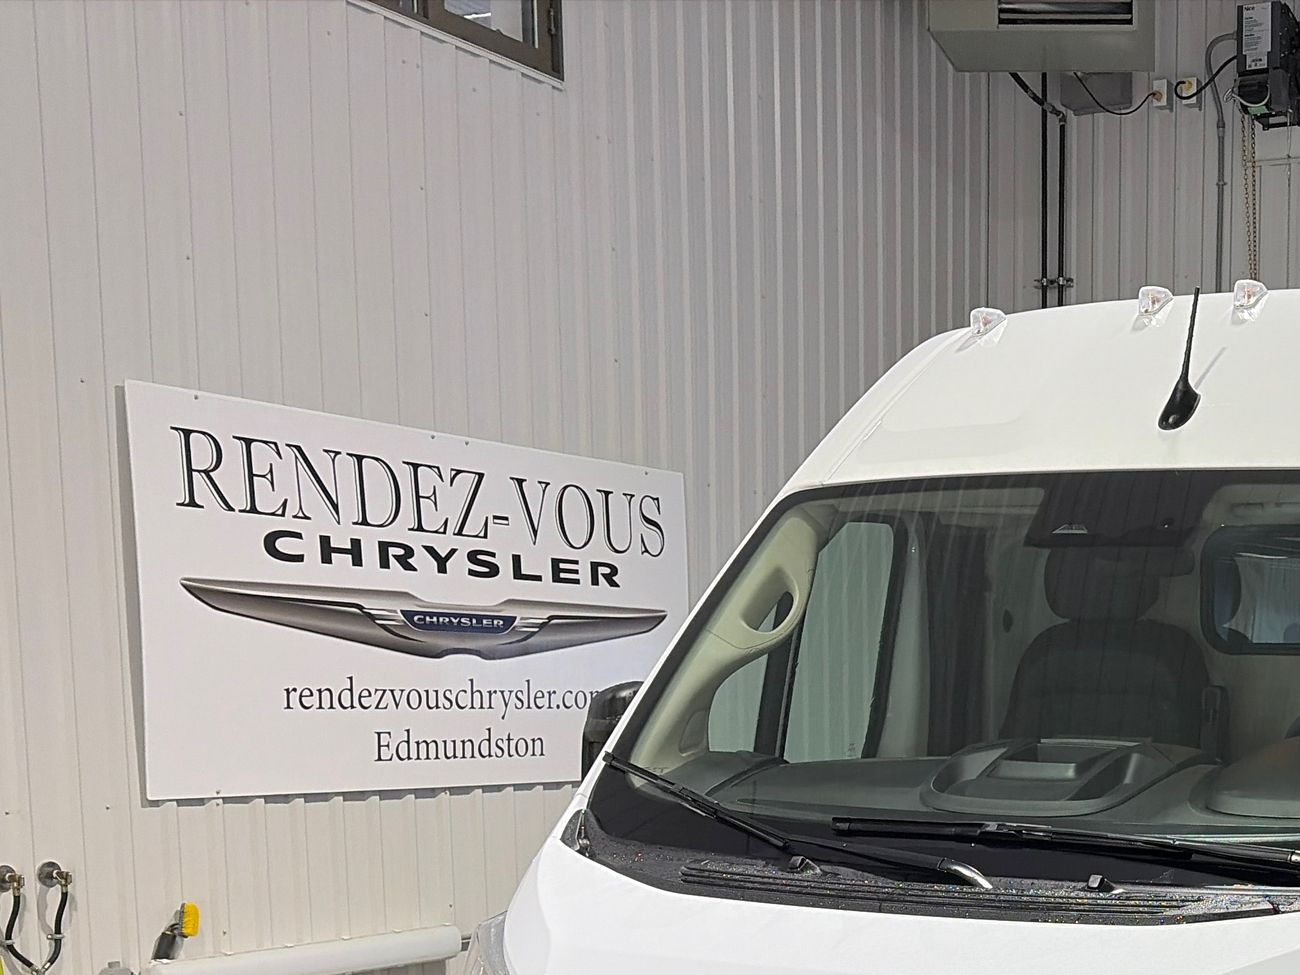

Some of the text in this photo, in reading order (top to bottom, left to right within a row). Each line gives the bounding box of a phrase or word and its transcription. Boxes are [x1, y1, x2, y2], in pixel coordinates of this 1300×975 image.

[169, 425, 667, 558] RENDEZ-VOUS
[263, 529, 621, 588] CHRYSLER
[413, 615, 504, 628] CHRYSLER
[374, 729, 546, 763] Edmundston
